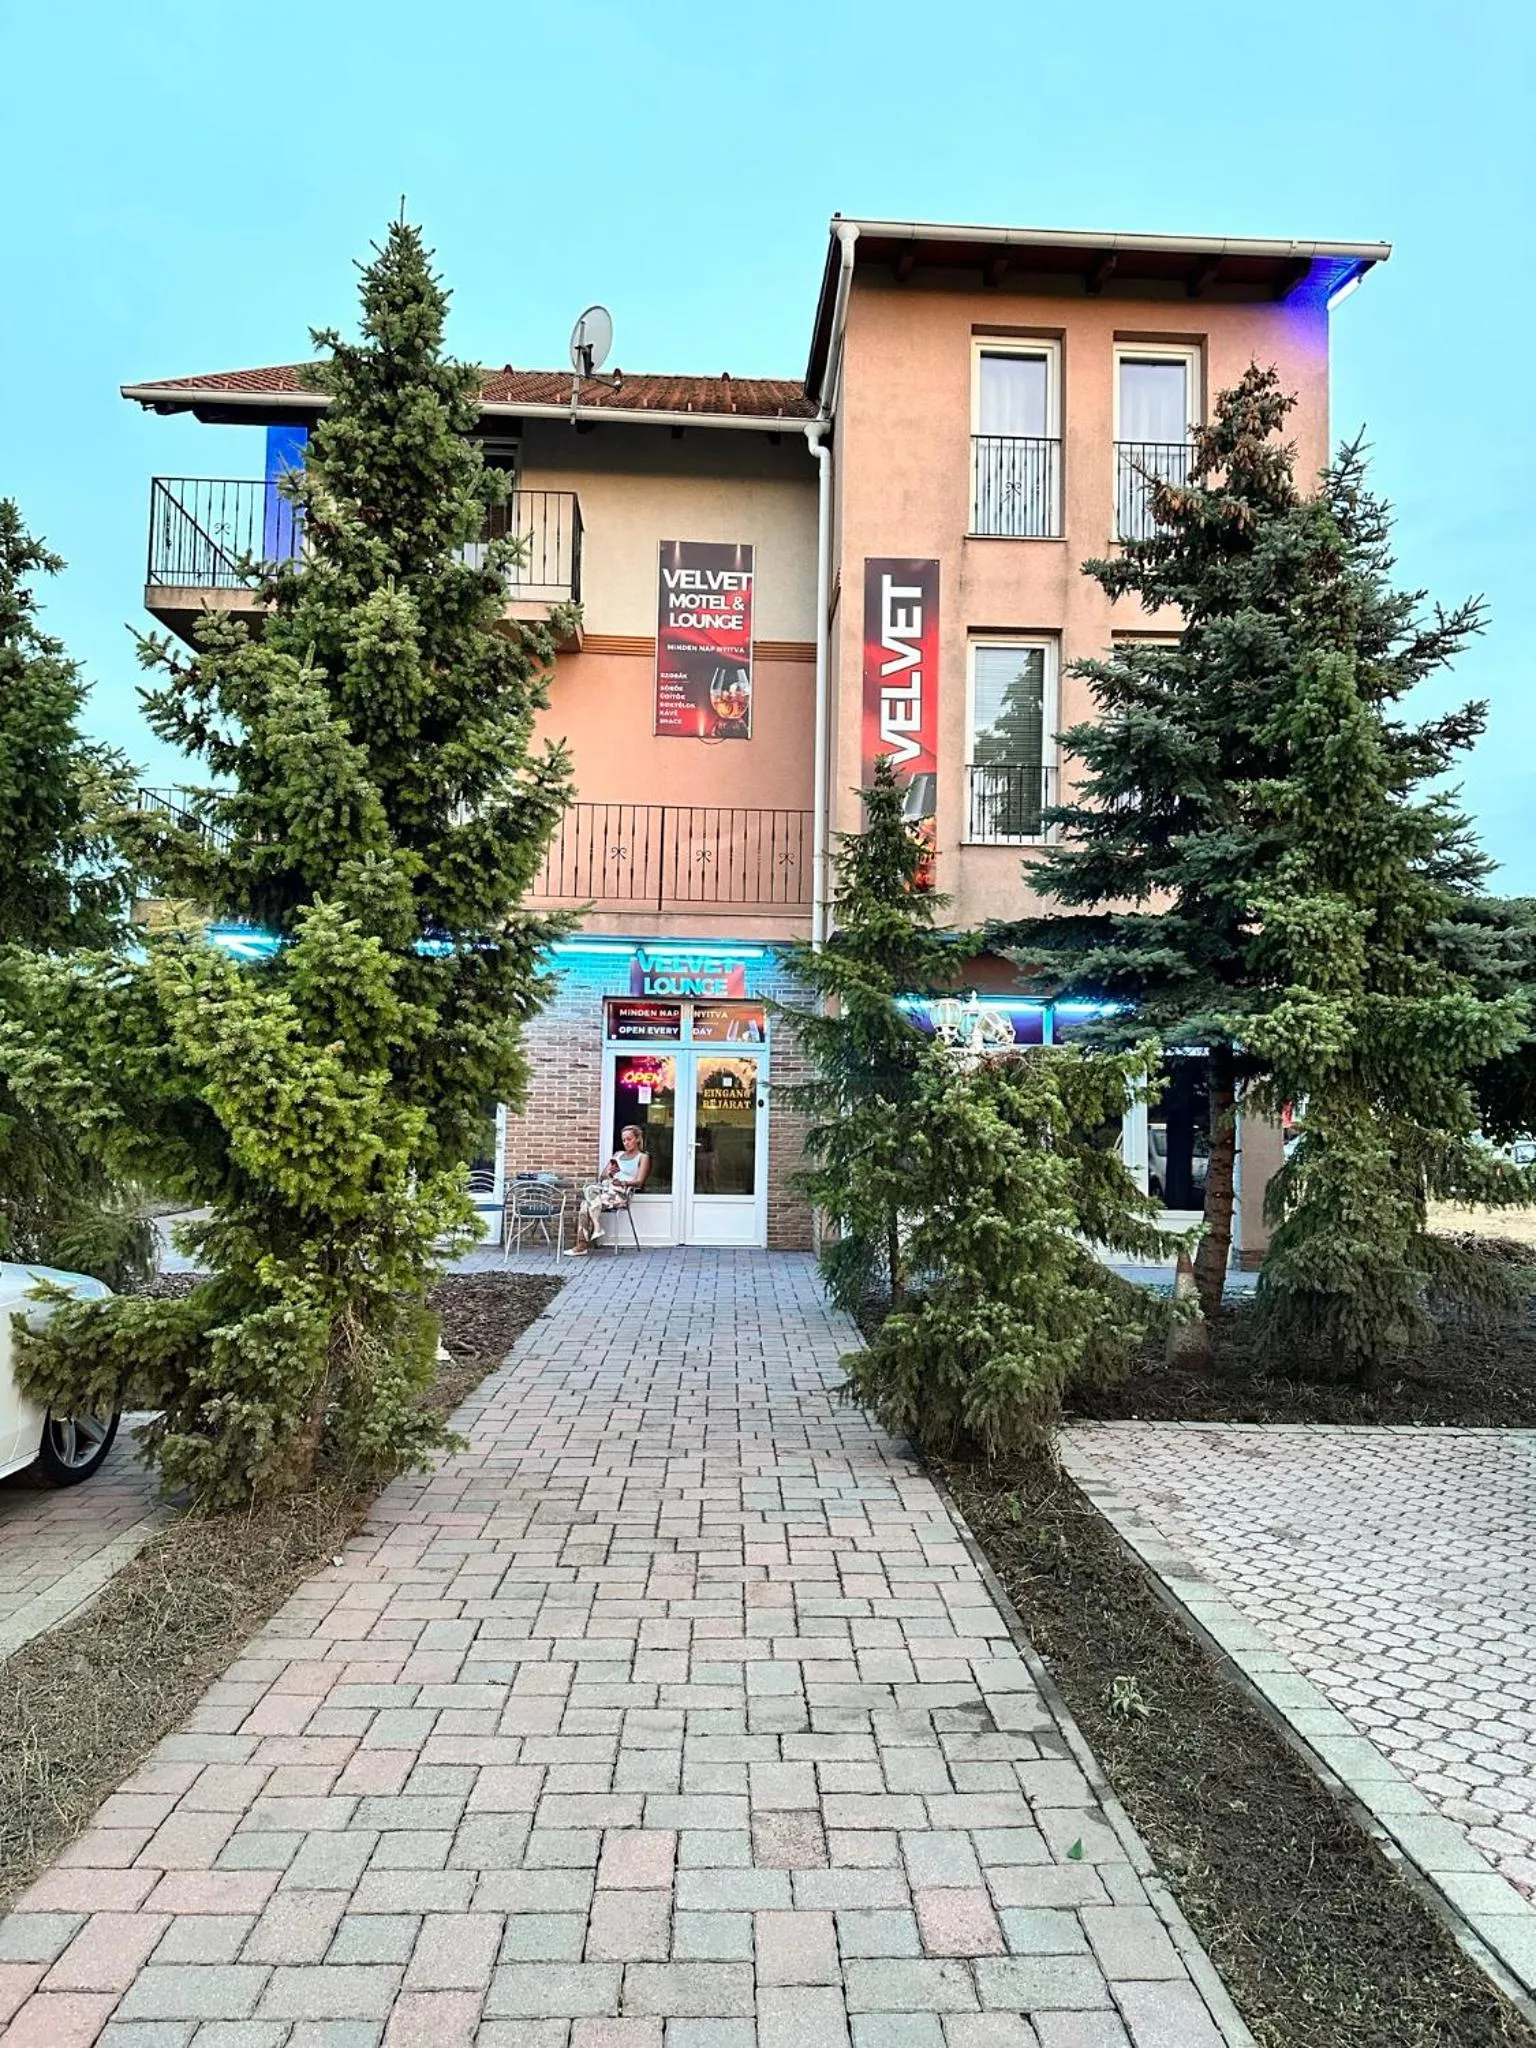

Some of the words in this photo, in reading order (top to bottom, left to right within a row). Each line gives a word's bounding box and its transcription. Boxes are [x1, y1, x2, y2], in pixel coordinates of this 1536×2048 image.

[662, 568, 753, 591] VELVET
[669, 593, 731, 610] MOTEL
[732, 596, 745, 611] &
[669, 613, 744, 630] LOUNGE
[667, 644, 698, 652] MINDEN
[699, 645, 716, 653] NAP
[880, 574, 923, 768] VELVET
[637, 949, 735, 973] VELVET
[643, 977, 729, 996] LOUNGE
[619, 1009, 657, 1017] MINDEN
[659, 1009, 680, 1017] NAP
[693, 1010, 728, 1019] NYITVA
[618, 1026, 646, 1035] OPEN
[647, 1026, 679, 1035] EVERY
[692, 1028, 713, 1036] DAY
[624, 1072, 663, 1083] OPEN
[703, 1089, 750, 1099] EINGANG
